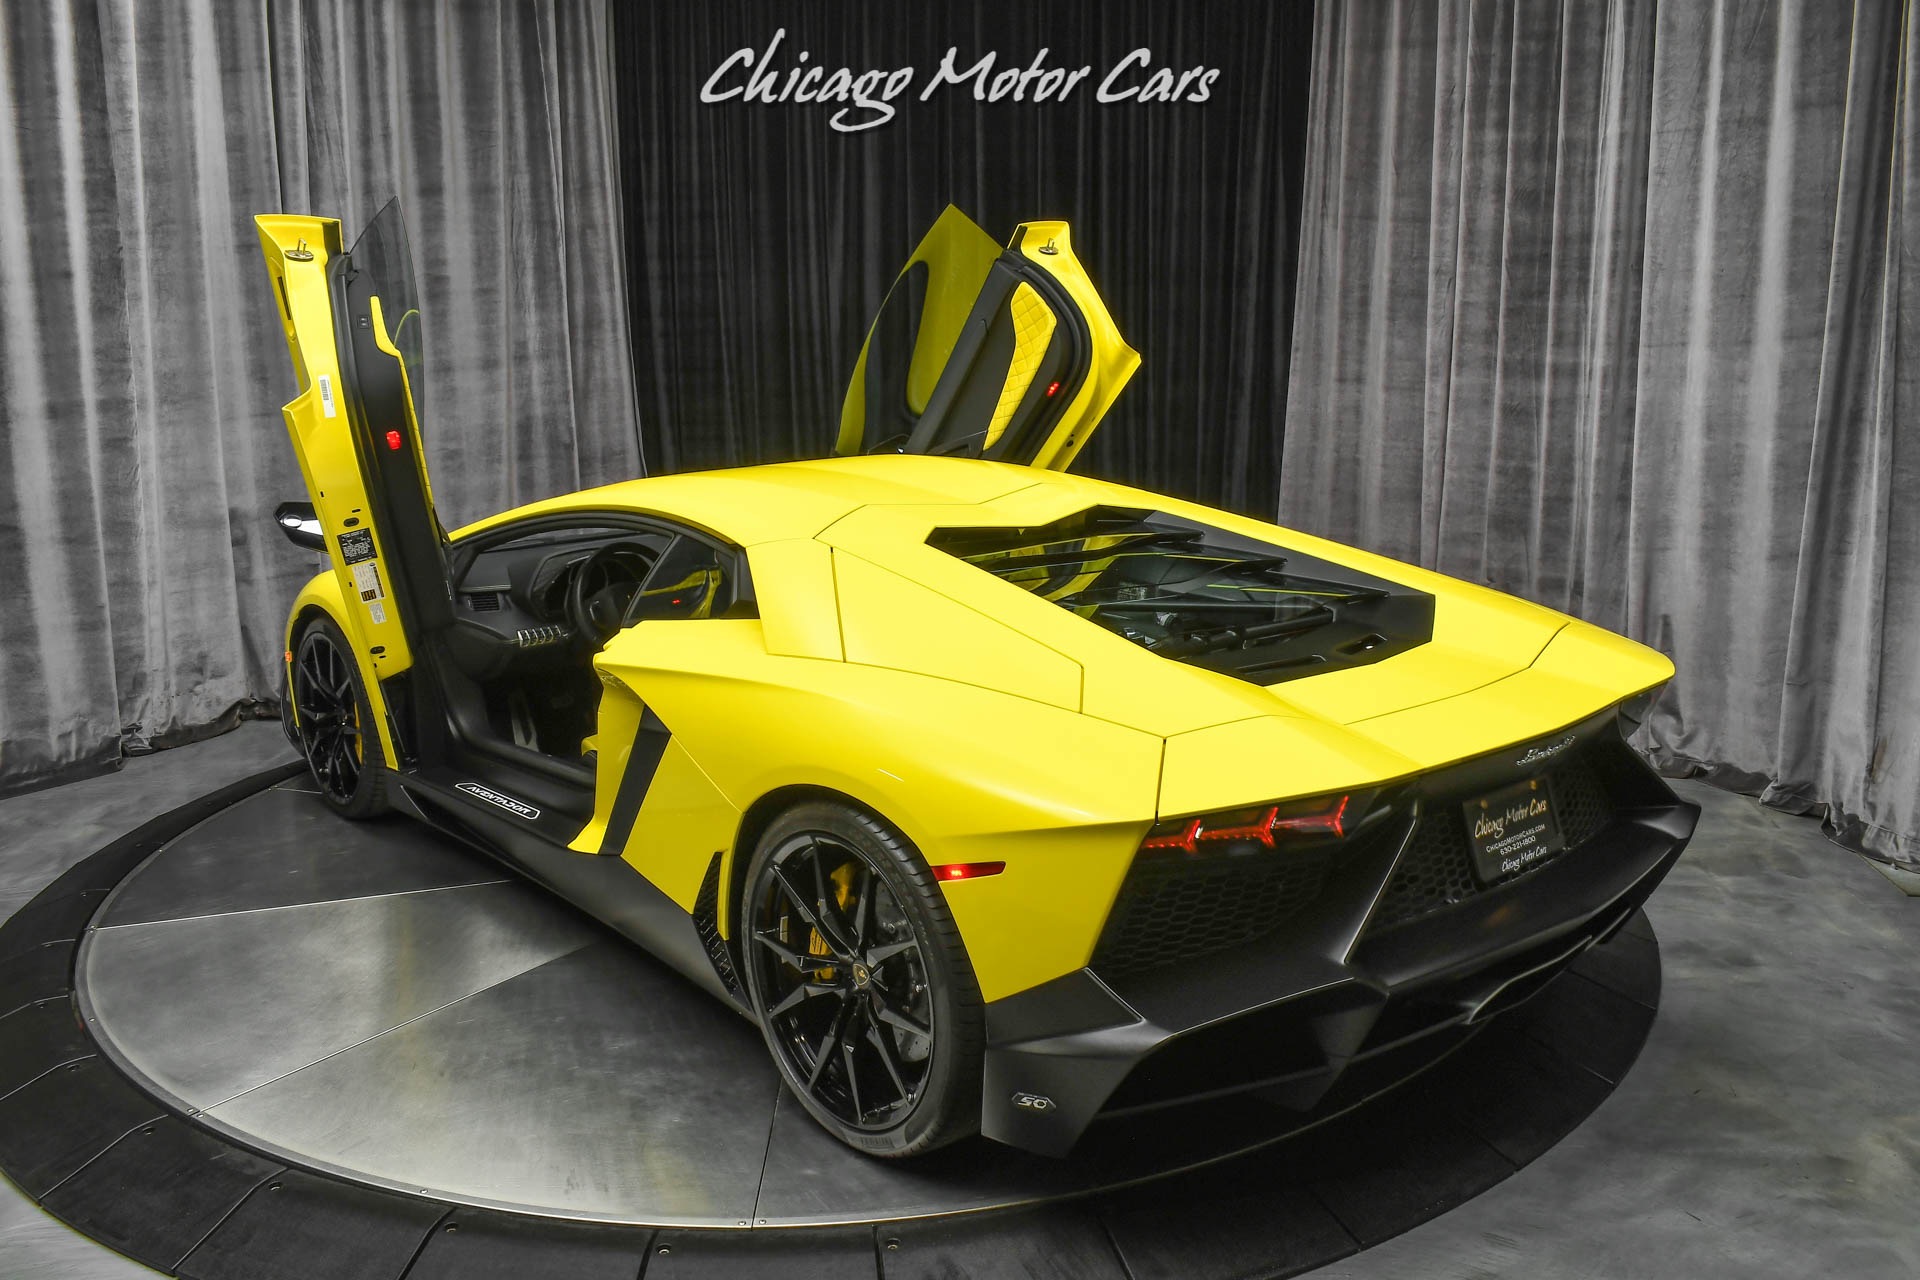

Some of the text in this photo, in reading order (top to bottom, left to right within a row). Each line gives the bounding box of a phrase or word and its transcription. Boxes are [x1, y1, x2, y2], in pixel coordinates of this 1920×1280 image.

[466, 786, 532, 814] AVENTADOR
[1474, 798, 1547, 839] Chicago Motor Cars
[1501, 858, 1521, 872] Chicago
[1535, 846, 1548, 857] Cars
[1018, 1096, 1048, 1109] 50
